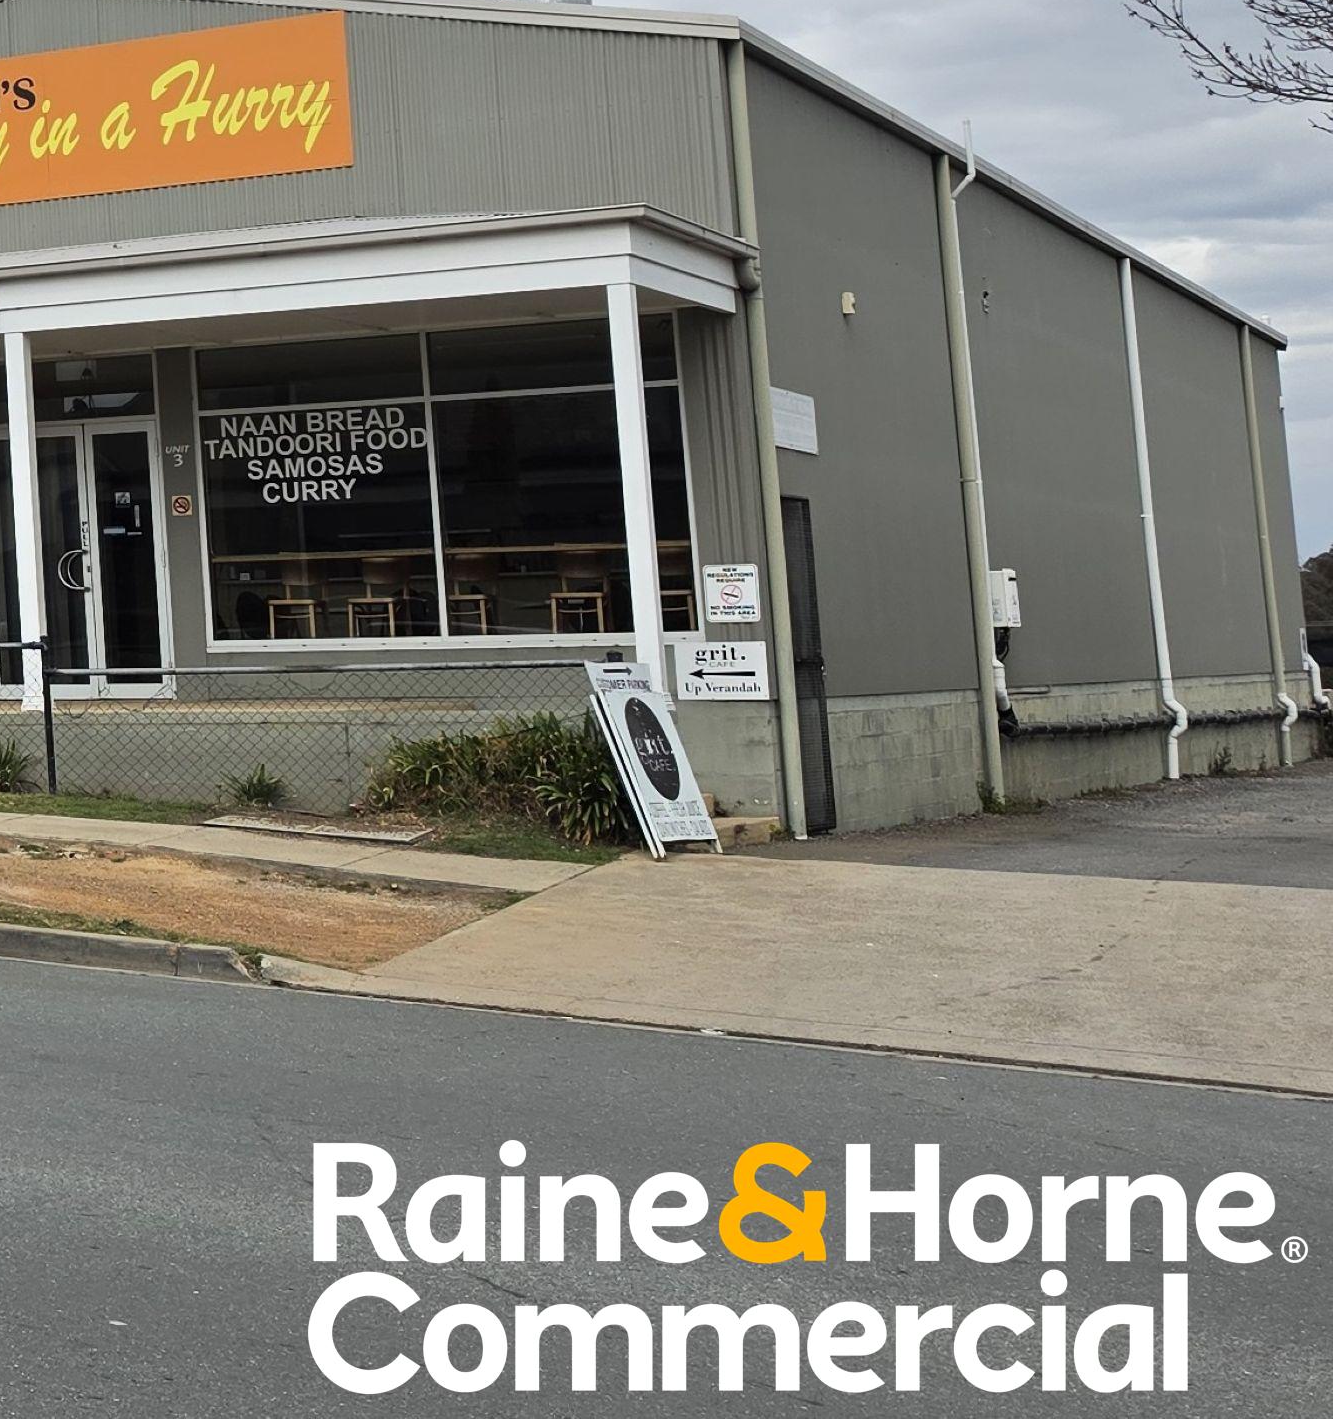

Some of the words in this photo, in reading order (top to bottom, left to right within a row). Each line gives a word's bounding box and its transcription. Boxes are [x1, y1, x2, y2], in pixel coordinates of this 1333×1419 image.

[29, 99, 79, 160] in
[100, 102, 137, 151] a
[151, 59, 331, 154] Hurry
[220, 413, 296, 437] NAAN
[306, 407, 405, 433] BREAD
[165, 445, 190, 454] UNIT
[204, 431, 341, 460] TANDOORI
[350, 427, 427, 451] FOOD
[173, 454, 183, 467] 3
[247, 453, 384, 480] SAMOSAS
[262, 478, 357, 504] CURRY
[695, 644, 746, 667] grit.
[685, 682, 702, 695] Up
[706, 681, 761, 693] Verandah
